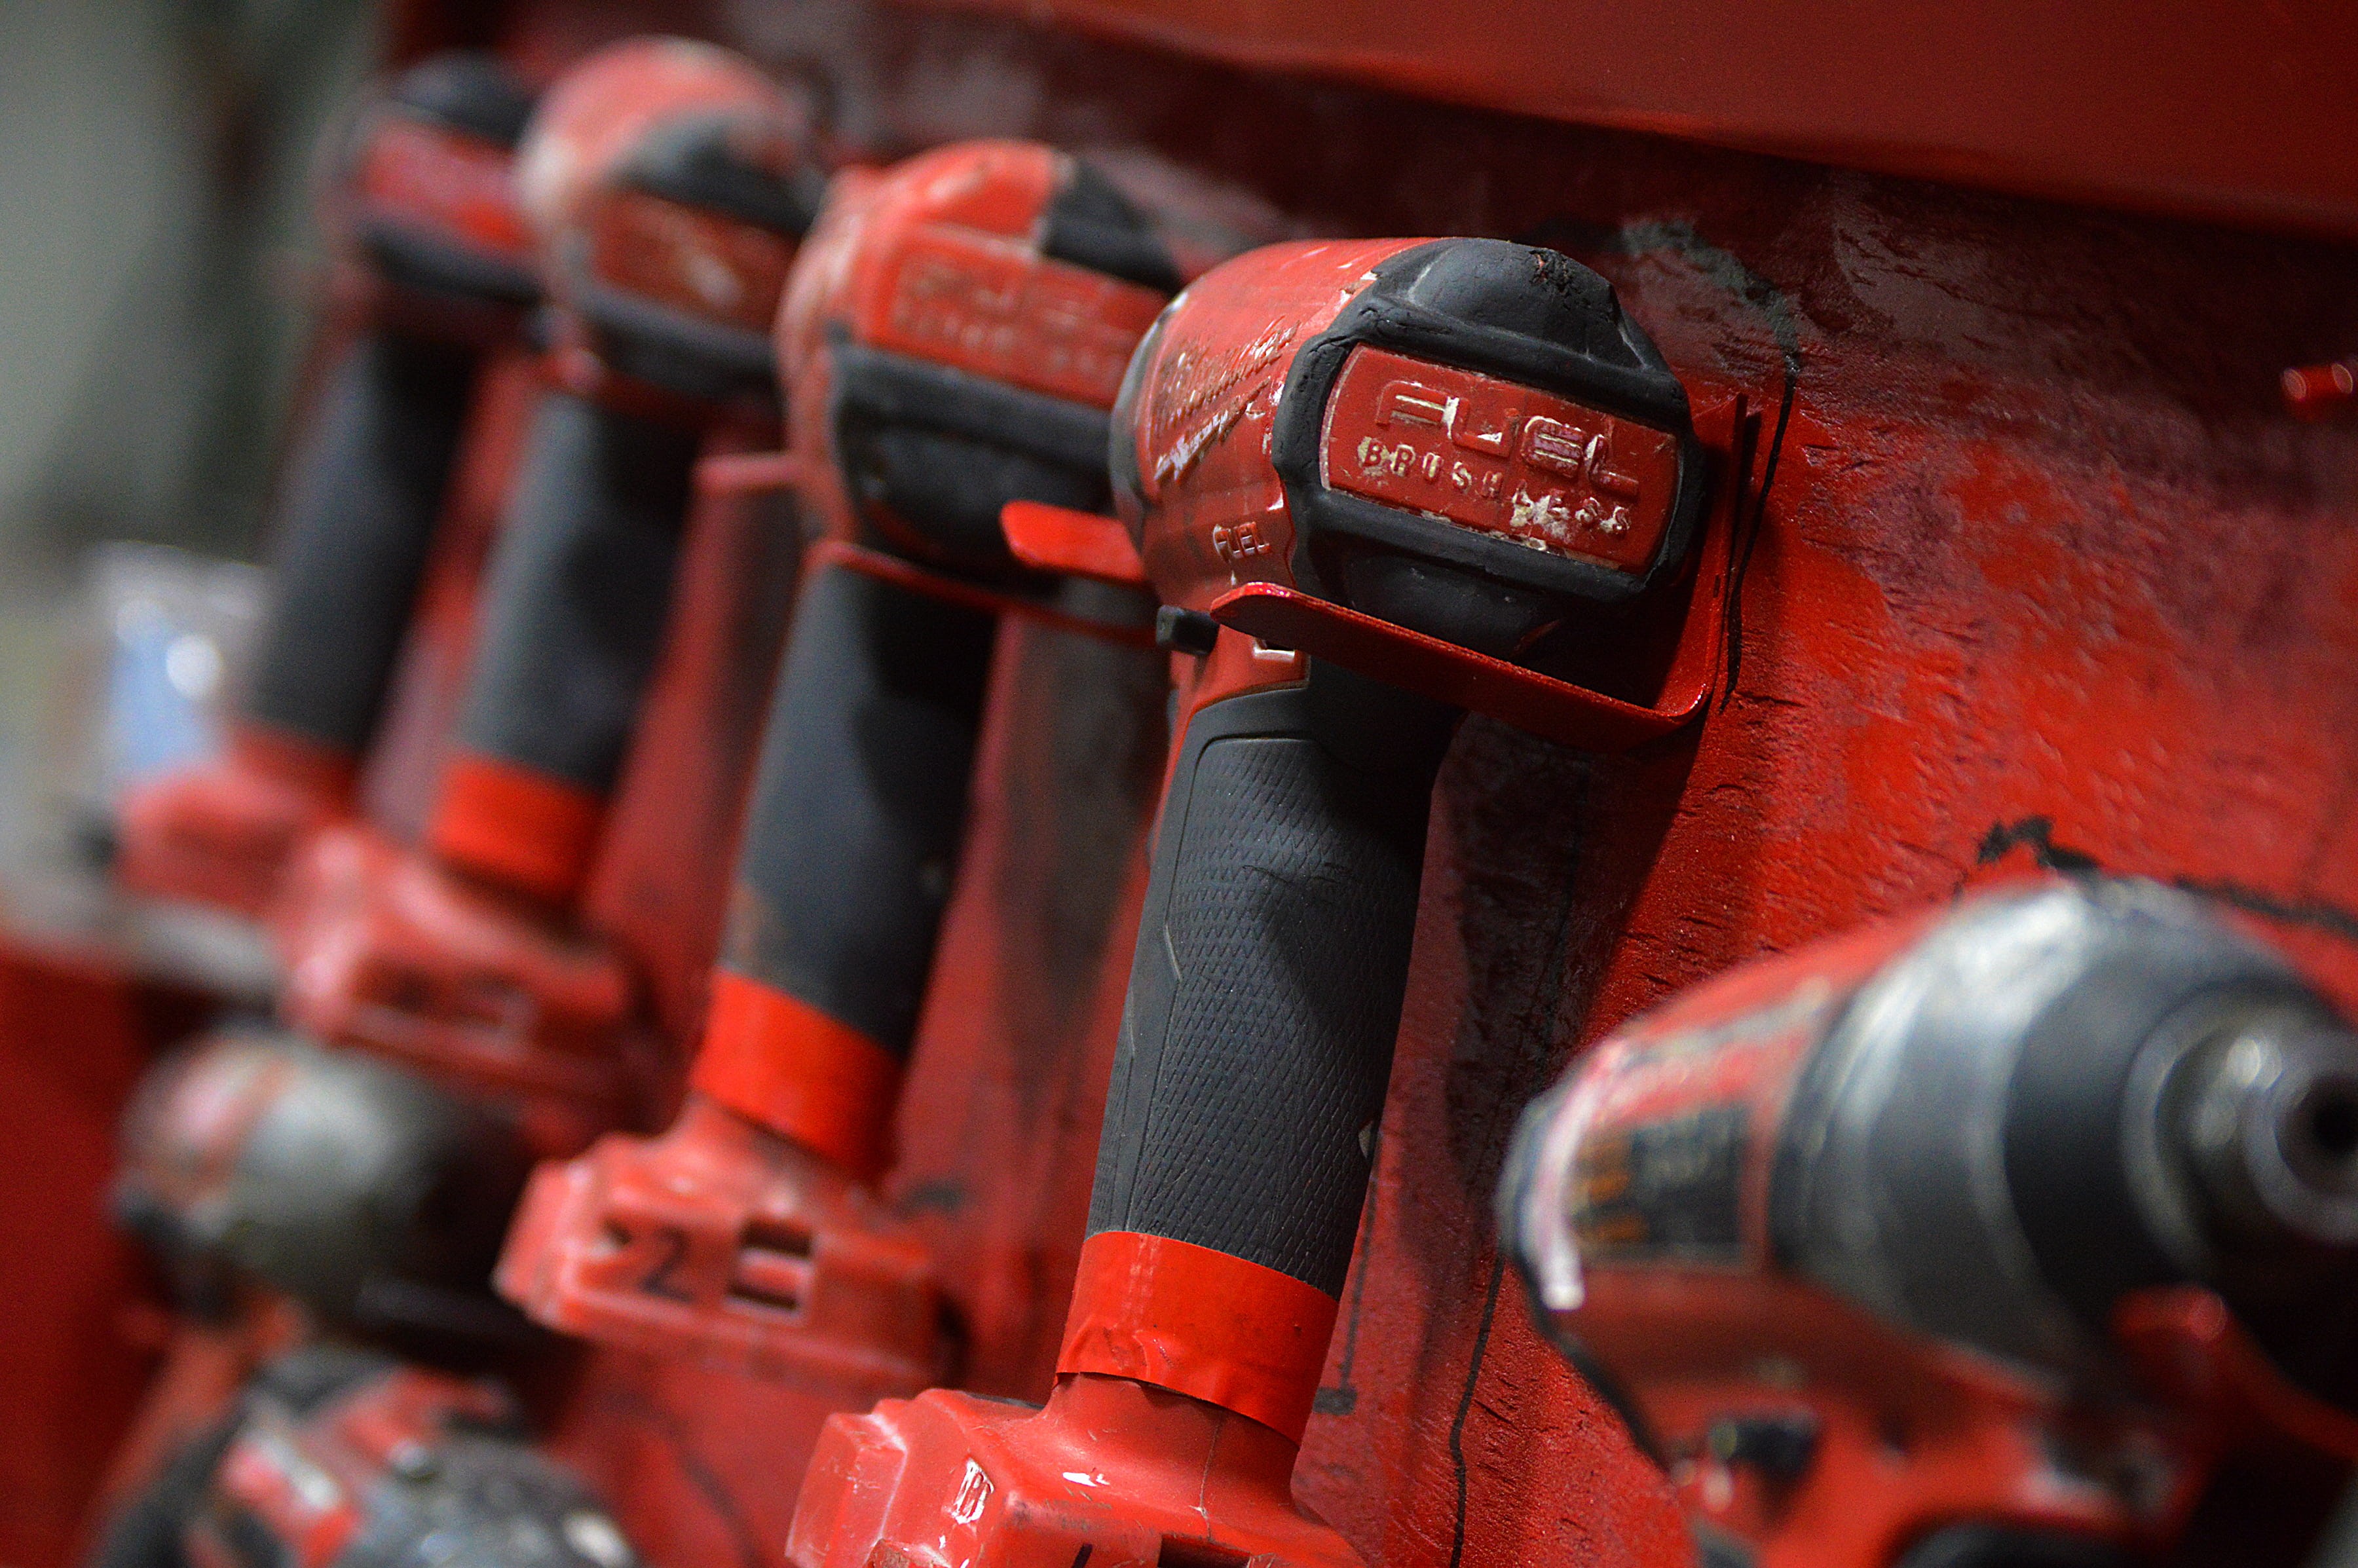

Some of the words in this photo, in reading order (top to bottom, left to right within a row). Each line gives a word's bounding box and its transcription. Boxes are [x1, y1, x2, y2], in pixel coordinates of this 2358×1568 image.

[1376, 380, 1639, 497] FUEL
[1360, 437, 1632, 536] BRUSHLESS
[1212, 521, 1271, 564] FUEL
[639, 1225, 694, 1304] 2
